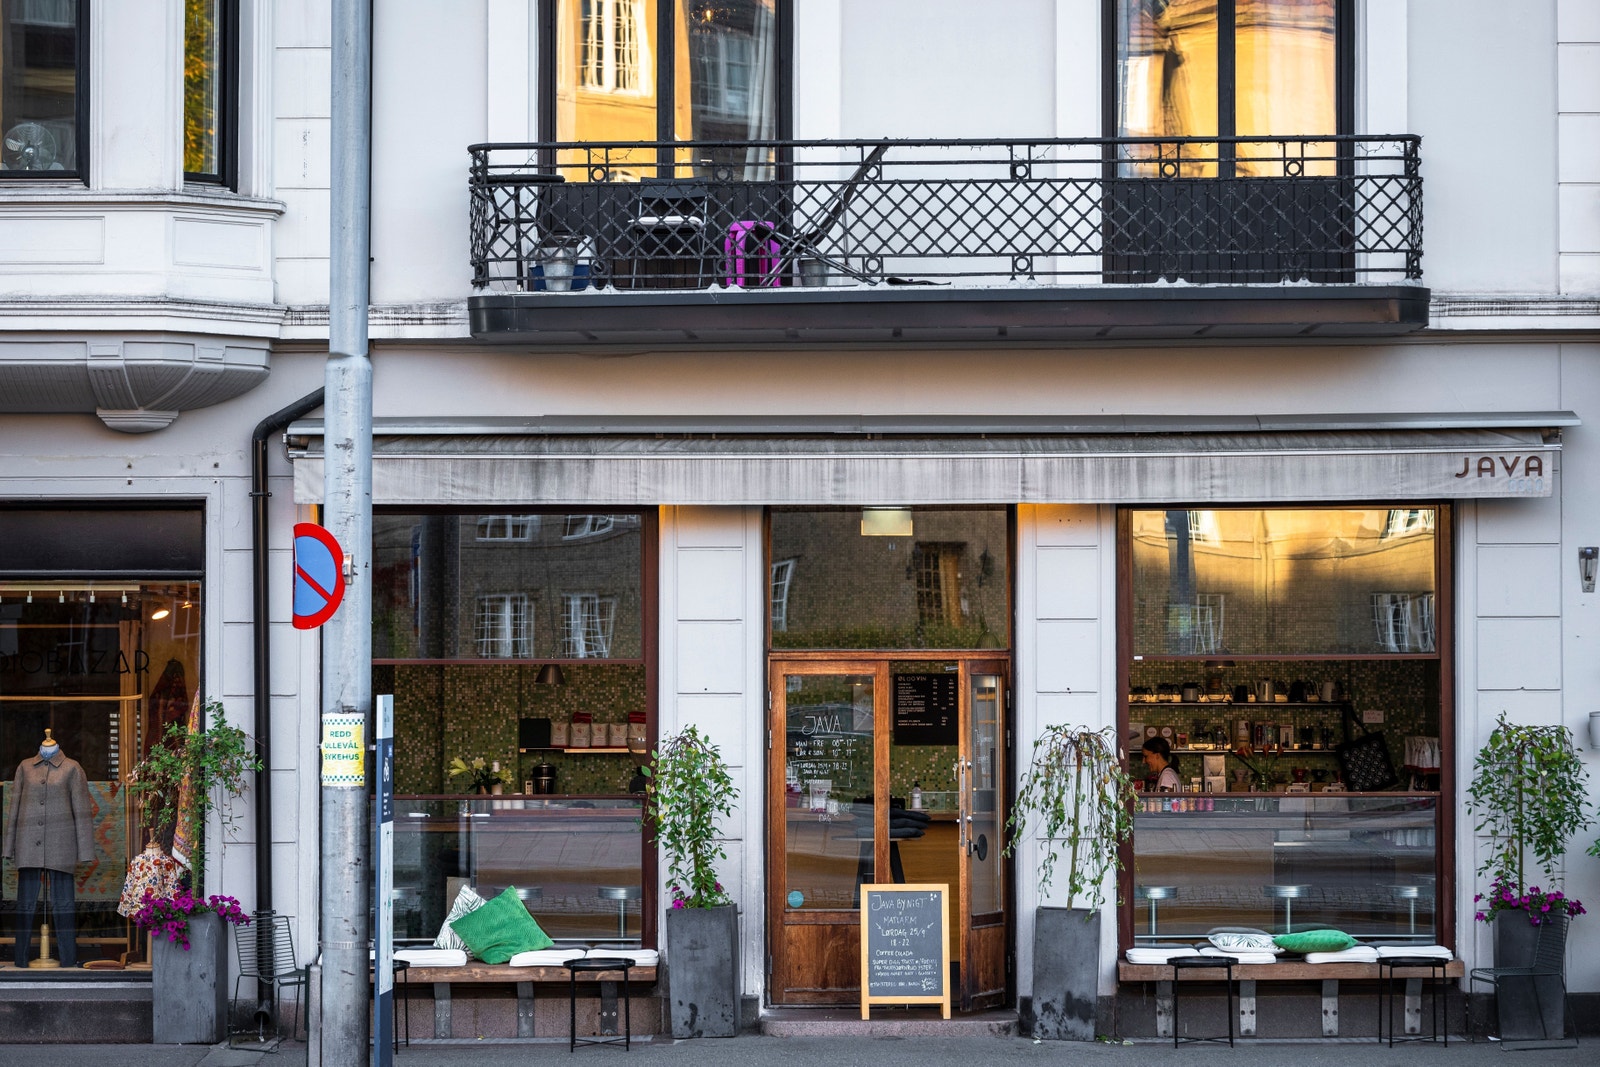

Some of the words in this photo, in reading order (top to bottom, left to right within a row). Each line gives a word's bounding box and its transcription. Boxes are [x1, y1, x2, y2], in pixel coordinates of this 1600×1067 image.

[1454, 455, 1543, 478] JAVA
[801, 715, 841, 735] JAVA
[329, 730, 352, 738] REDD
[324, 740, 359, 749] ULLEVÅL
[324, 753, 360, 761] SYKEHUS
[871, 894, 895, 911] JAVA
[896, 898, 906, 910] BY
[881, 928, 907, 938] LØRDAG
